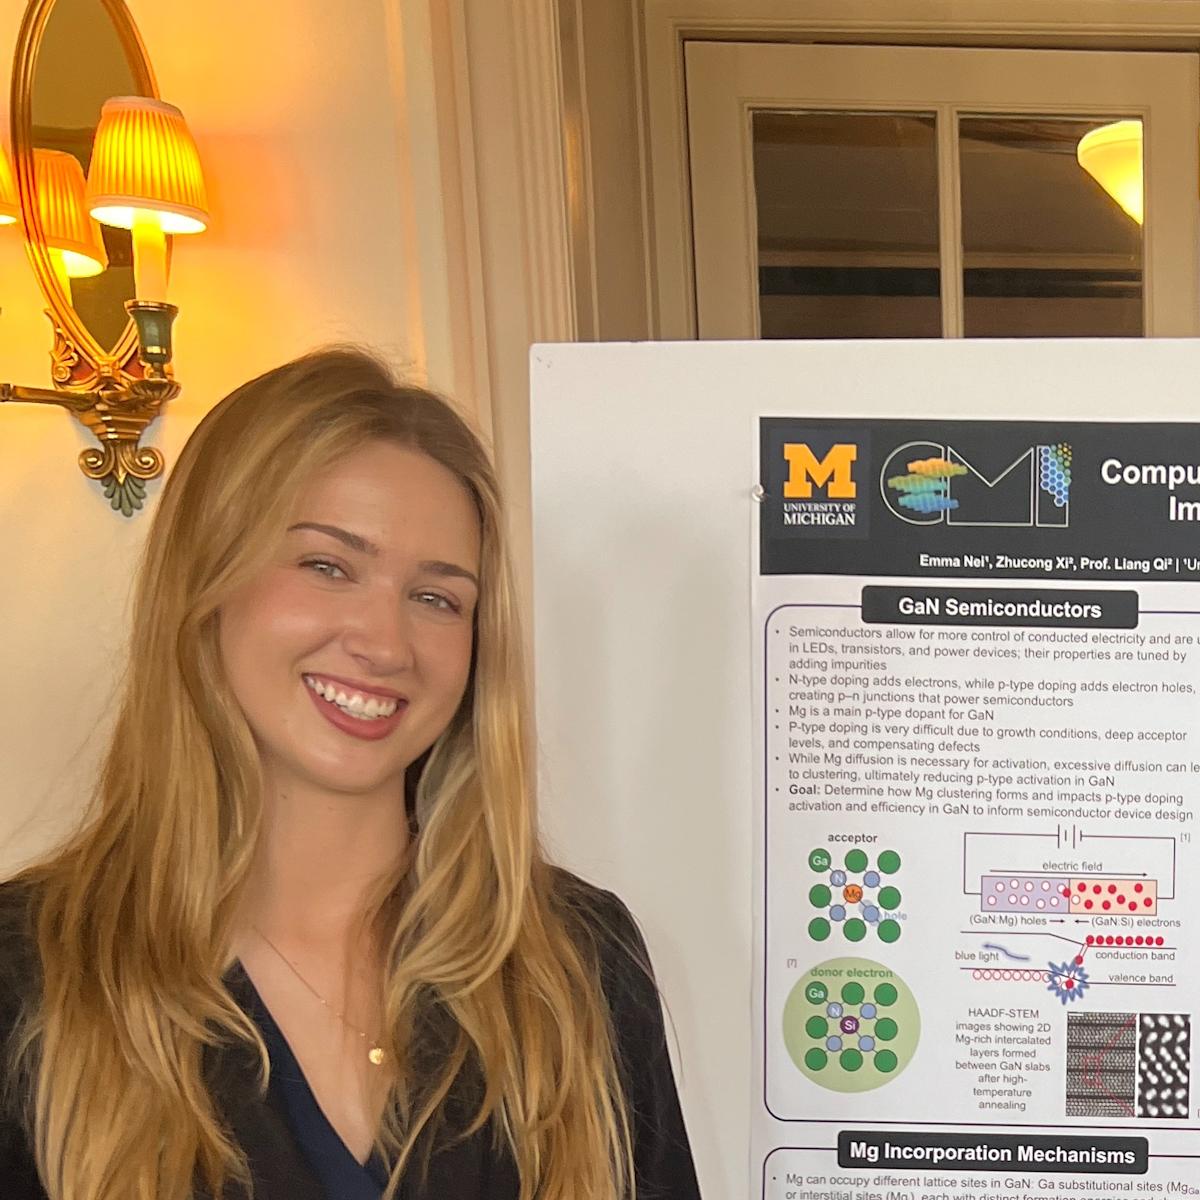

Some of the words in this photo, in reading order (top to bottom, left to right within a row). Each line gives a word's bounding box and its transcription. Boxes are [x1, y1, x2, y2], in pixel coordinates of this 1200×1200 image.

[842, 504, 856, 512] OF
[784, 514, 856, 525] MICHIGAN
[919, 553, 960, 567] Emma
[995, 555, 1052, 571] Zhucong
[1080, 557, 1111, 570] Prof.
[1114, 557, 1150, 573] Liang
[898, 597, 939, 615] GaN
[945, 598, 1101, 618] Semiconductors
[788, 625, 882, 639] Semiconductors
[885, 628, 916, 639] allow
[919, 628, 935, 640] for
[937, 631, 967, 641] more
[970, 630, 1010, 641] control
[1013, 630, 1025, 642] of
[1027, 631, 1088, 643] conducted
[1091, 632, 1145, 647] electricity
[1148, 633, 1170, 644] and
[1174, 635, 1193, 645] are
[788, 704, 806, 722] Mg
[809, 705, 819, 716] is
[822, 707, 829, 716] a
[833, 706, 861, 719] main
[865, 706, 901, 720] p-type
[904, 707, 945, 721] dopant
[948, 708, 964, 720] for
[967, 708, 994, 720] GaN
[827, 833, 877, 845] acceptor
[1042, 862, 1079, 871] electric
[1082, 862, 1102, 872] field
[1095, 950, 1148, 960] conduction
[1150, 951, 1175, 961] band
[1108, 974, 1146, 982] valence
[1149, 974, 1174, 982] band
[968, 1007, 1039, 1018] HAADF-STEM
[850, 1141, 879, 1162] Mg
[884, 1142, 1011, 1164] Incorporation
[1017, 1145, 1135, 1164] Mechanisms
